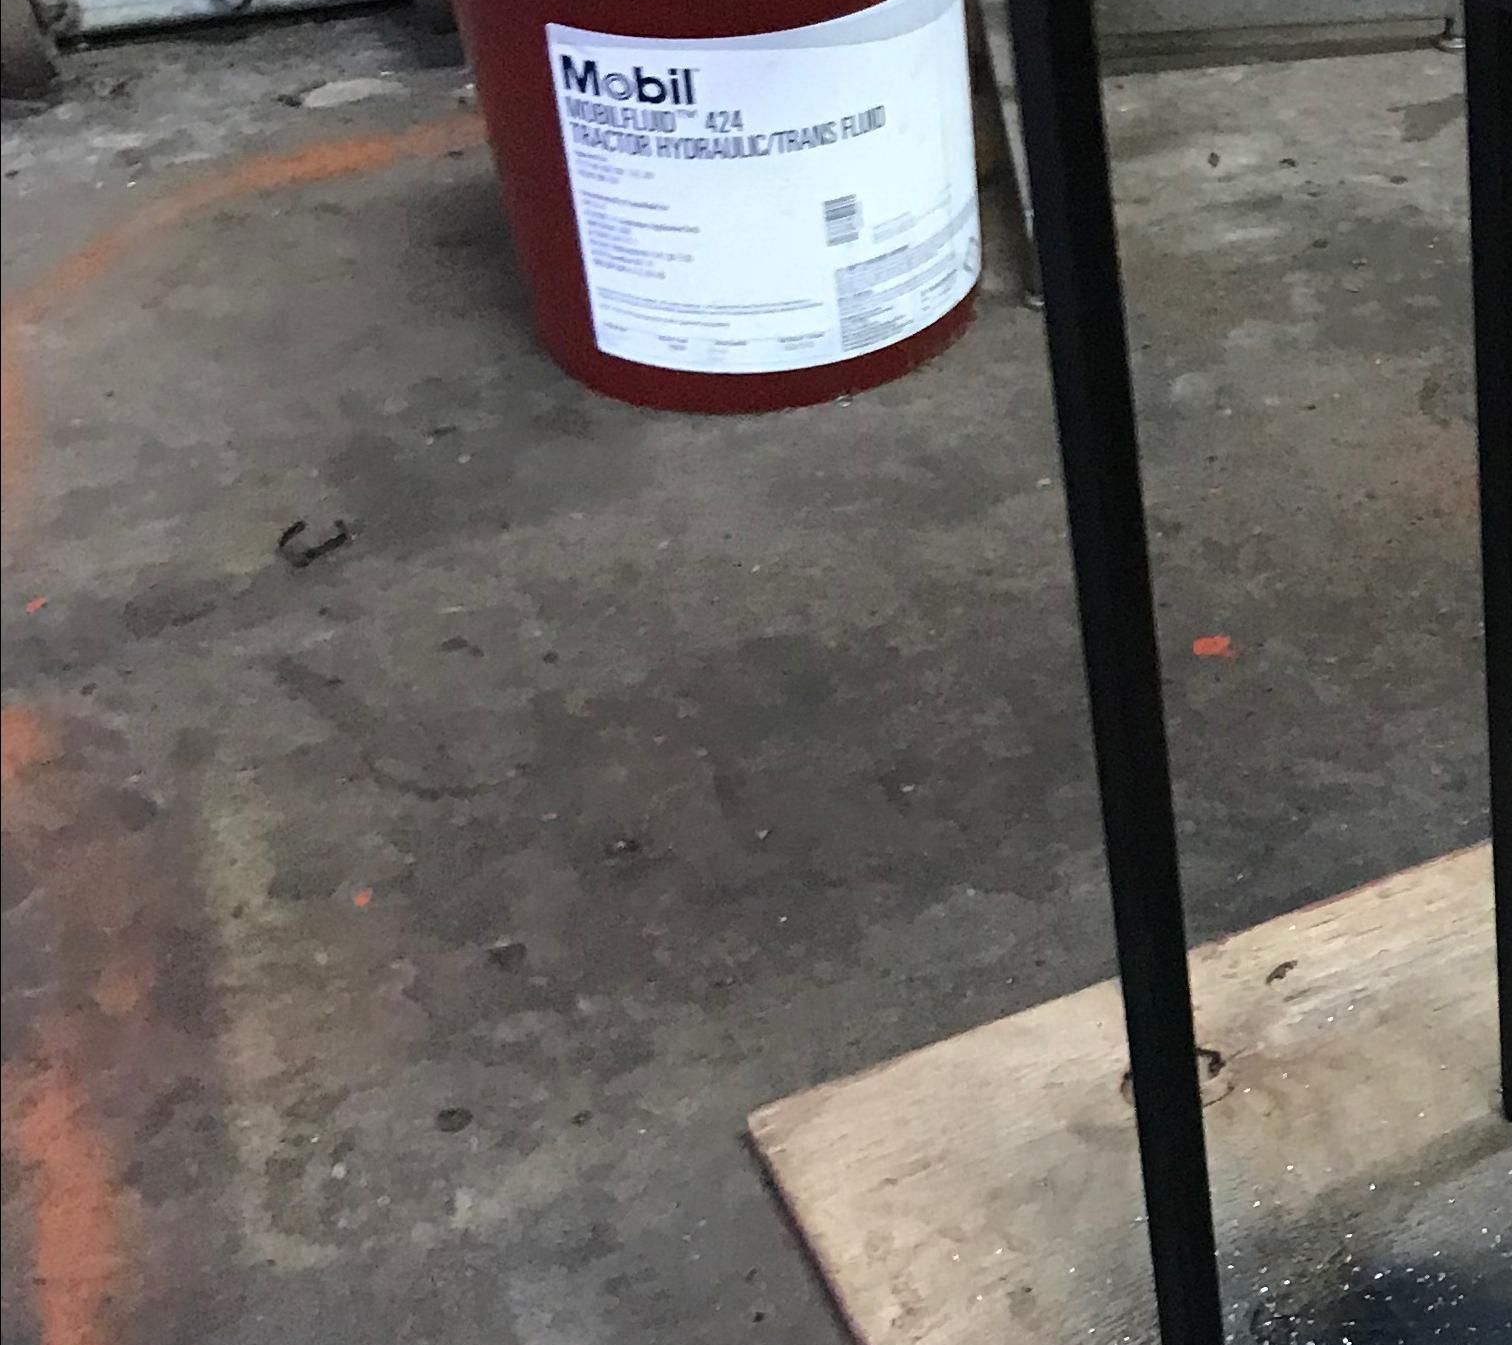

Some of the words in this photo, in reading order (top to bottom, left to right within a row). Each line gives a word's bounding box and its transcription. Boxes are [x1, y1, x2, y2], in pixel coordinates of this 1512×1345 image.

[561, 54, 697, 105] Mobil
[569, 121, 651, 157] TRACTOR
[841, 105, 886, 140] FLUID
[705, 110, 744, 133] 424
